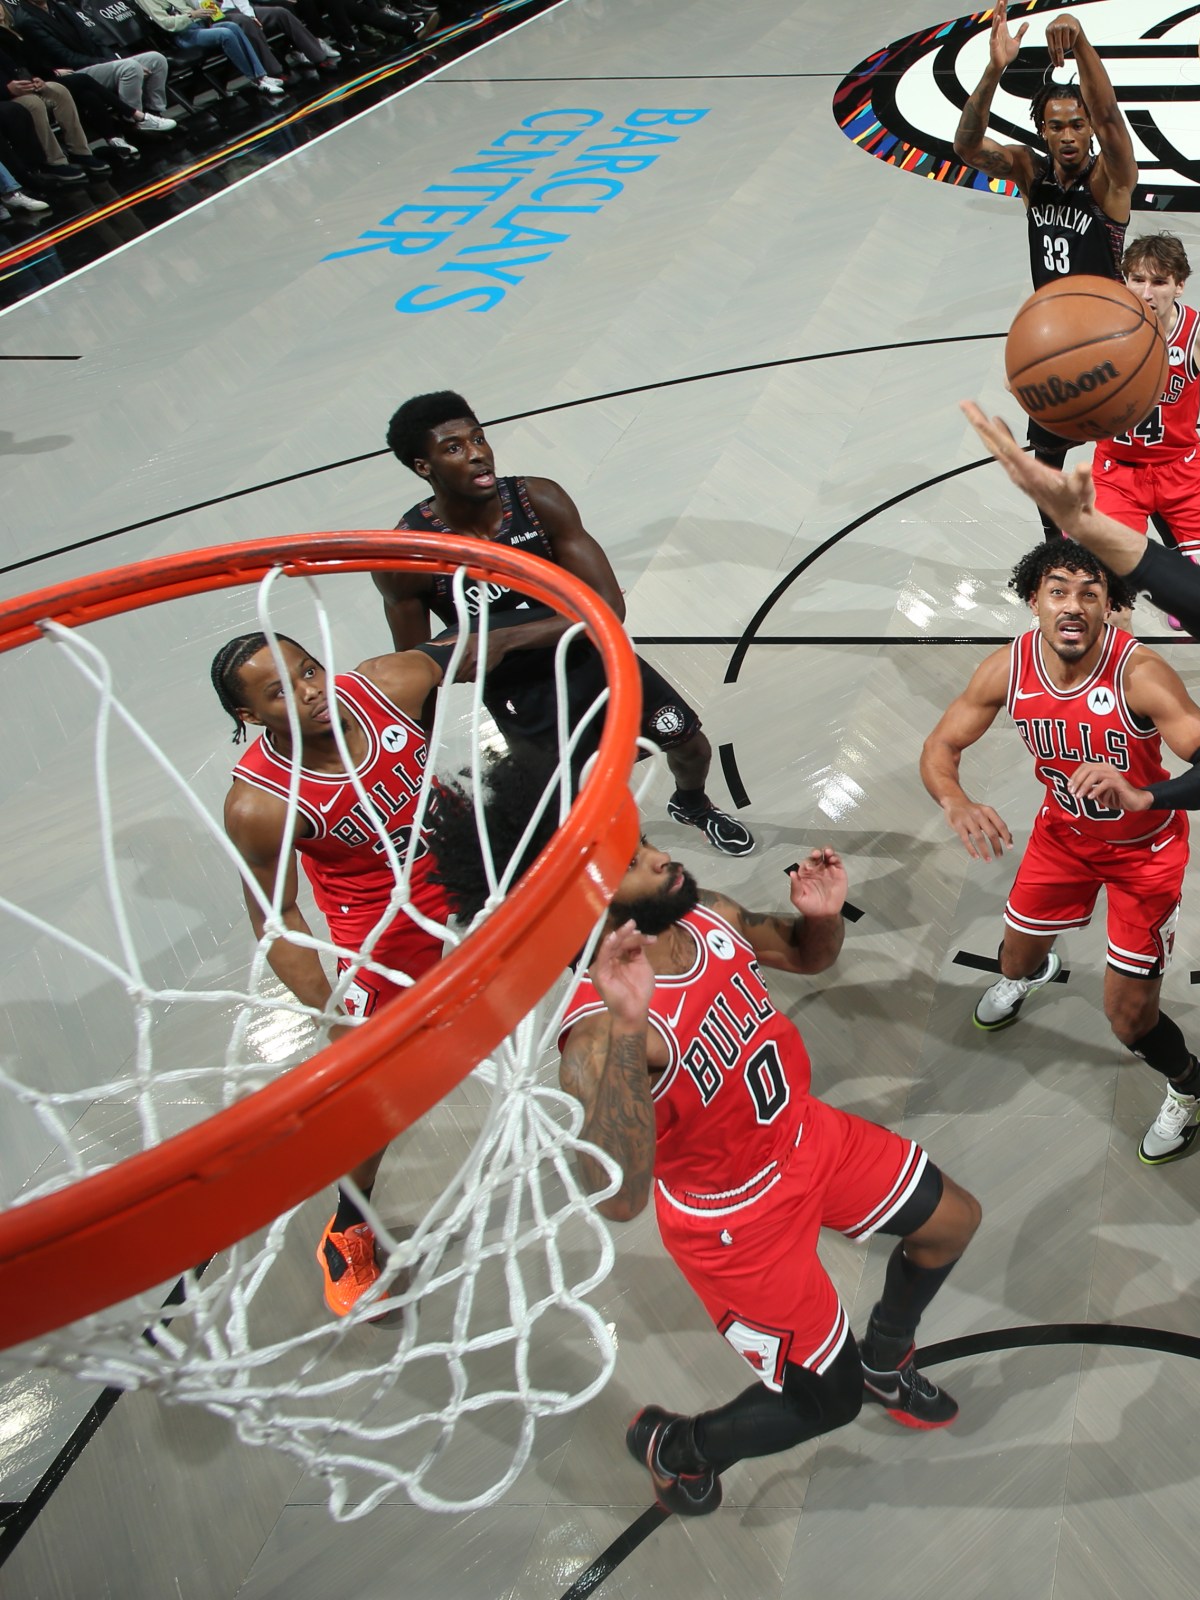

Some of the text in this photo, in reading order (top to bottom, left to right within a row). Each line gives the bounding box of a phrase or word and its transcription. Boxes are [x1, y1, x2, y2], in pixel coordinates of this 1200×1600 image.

[99, 1, 130, 20] QATAR
[319, 108, 604, 262] CENTER
[394, 108, 712, 314] BARCLAYS
[1043, 234, 1070, 274] 33
[1017, 360, 1119, 412] Wilson
[743, 1039, 790, 1125] 0
